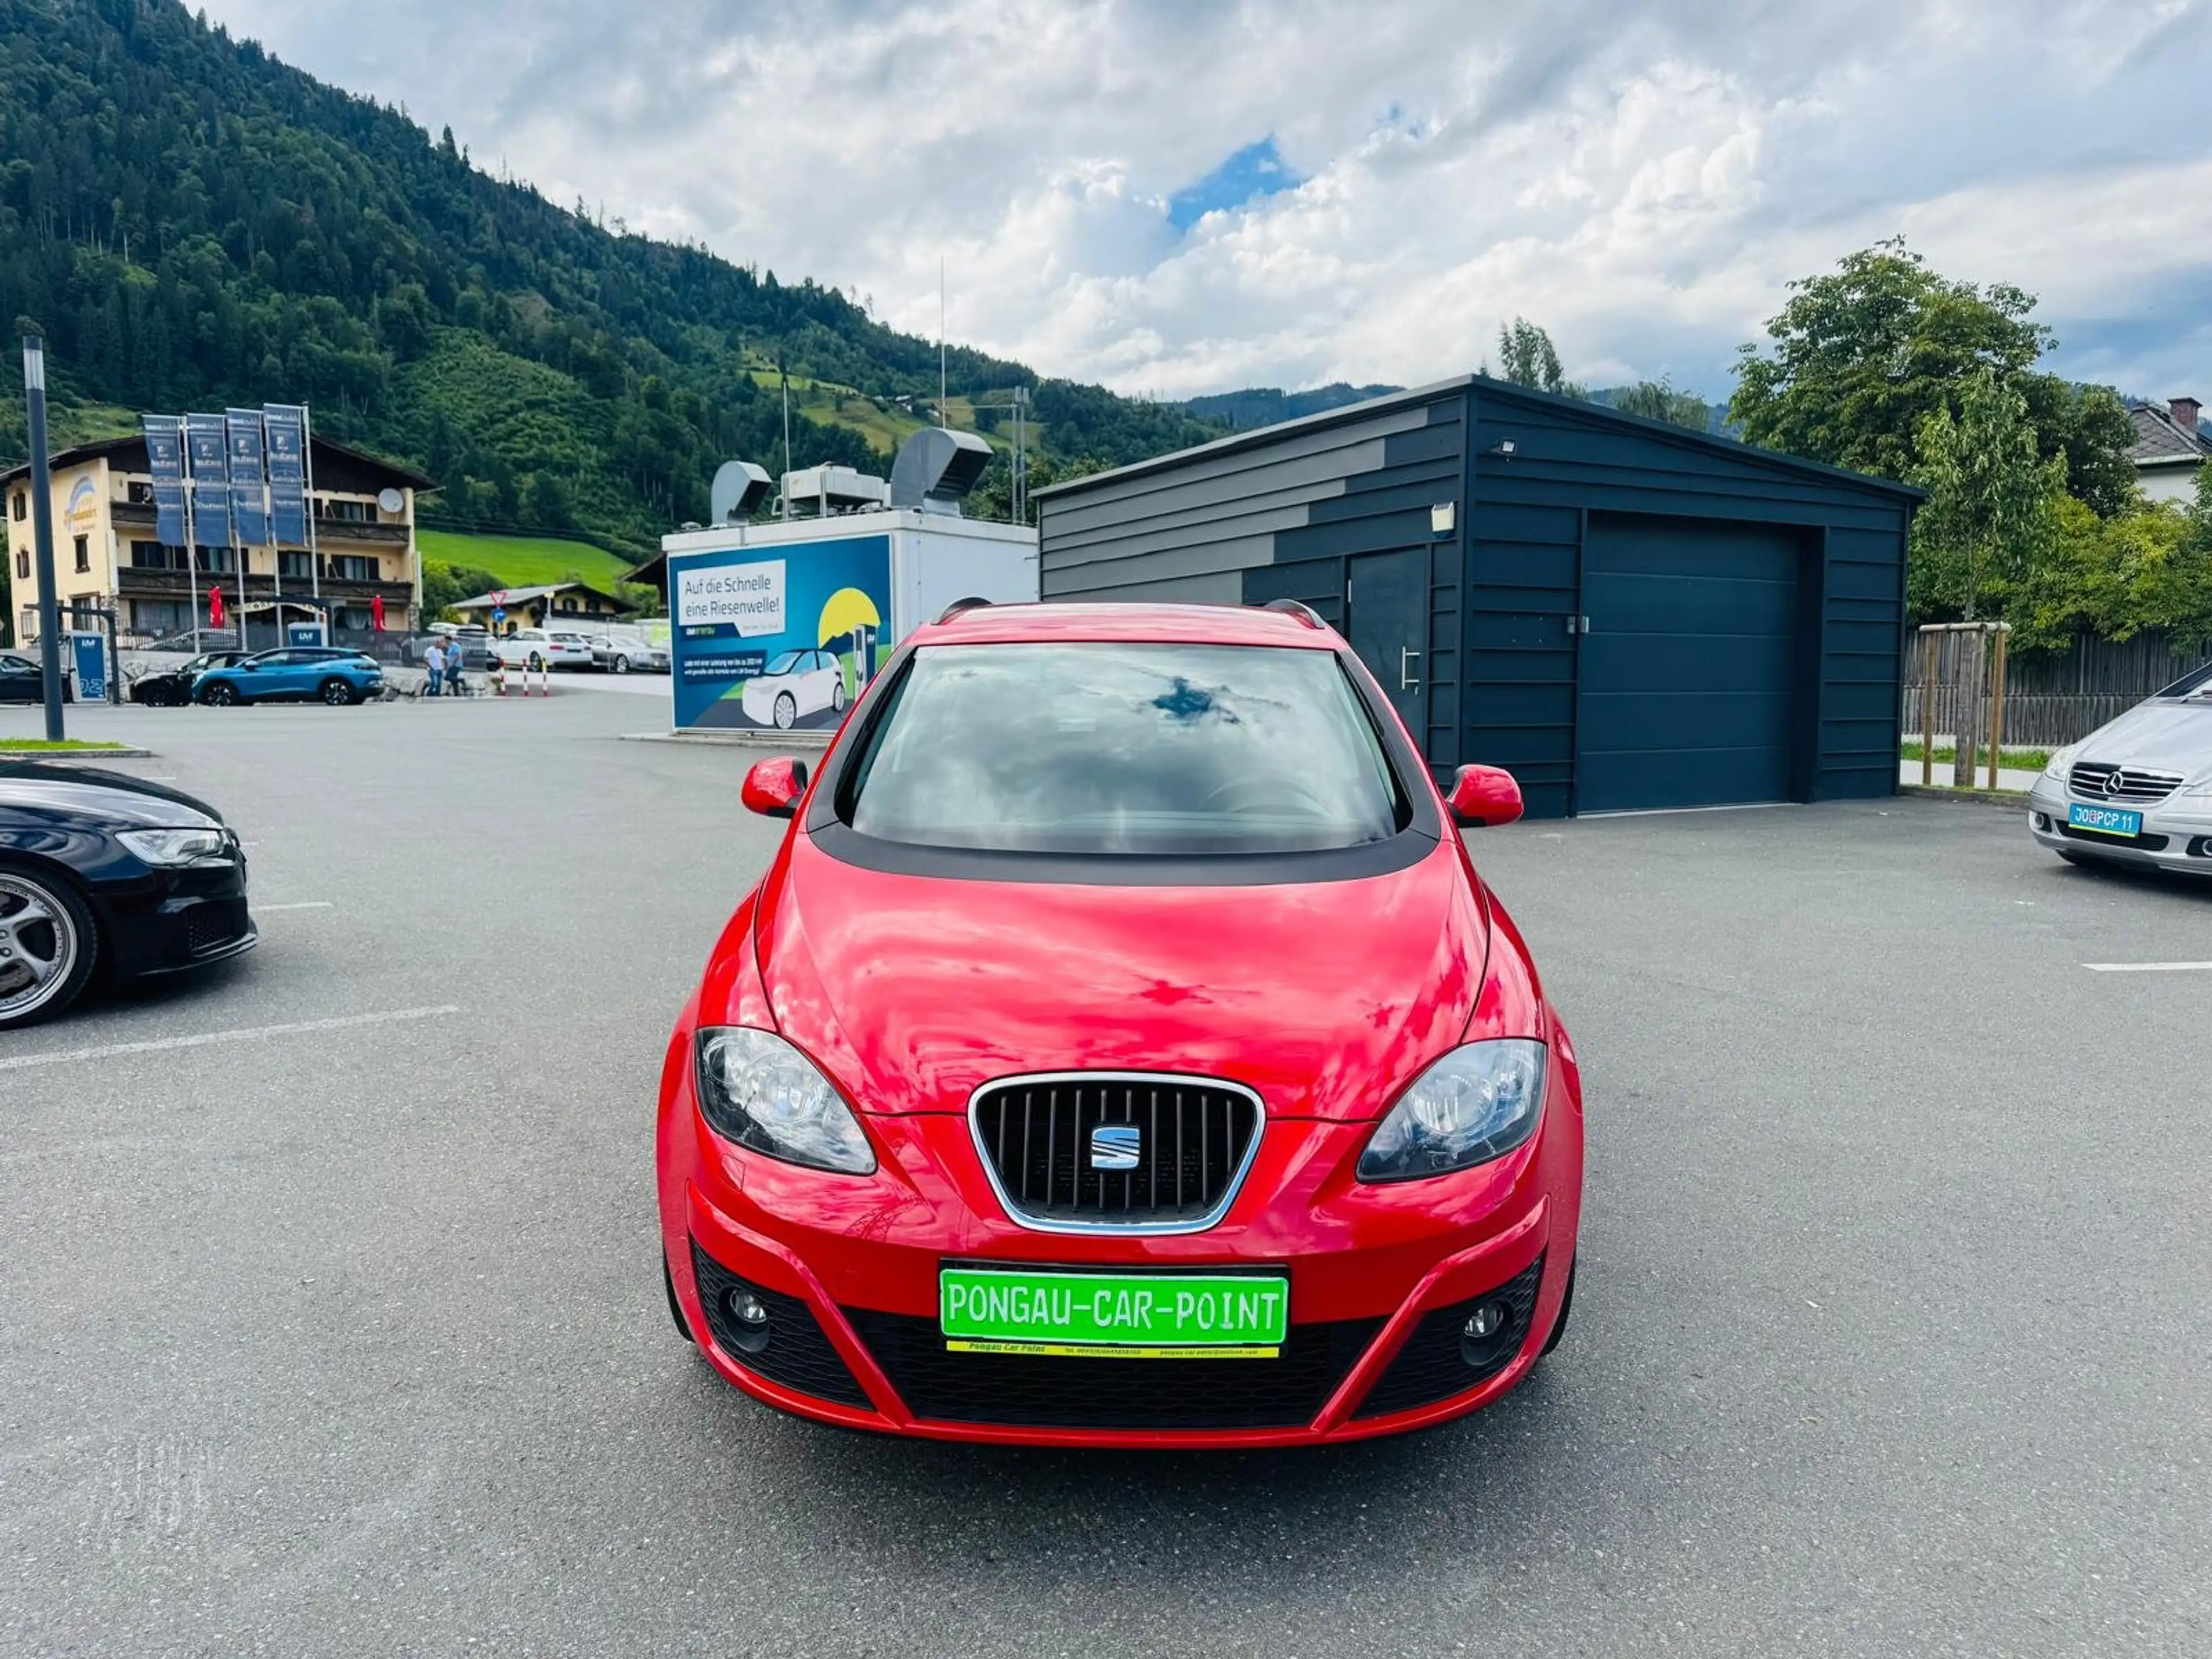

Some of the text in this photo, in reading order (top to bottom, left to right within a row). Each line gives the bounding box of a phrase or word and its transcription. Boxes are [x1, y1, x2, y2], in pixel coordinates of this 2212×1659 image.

[685, 575, 771, 594] Auf die Schnelle
[685, 597, 779, 617] eine Riesenwelle!
[2122, 815, 2133, 830] 11
[948, 1283, 1279, 1330] PONGAU-CAR-POINT
